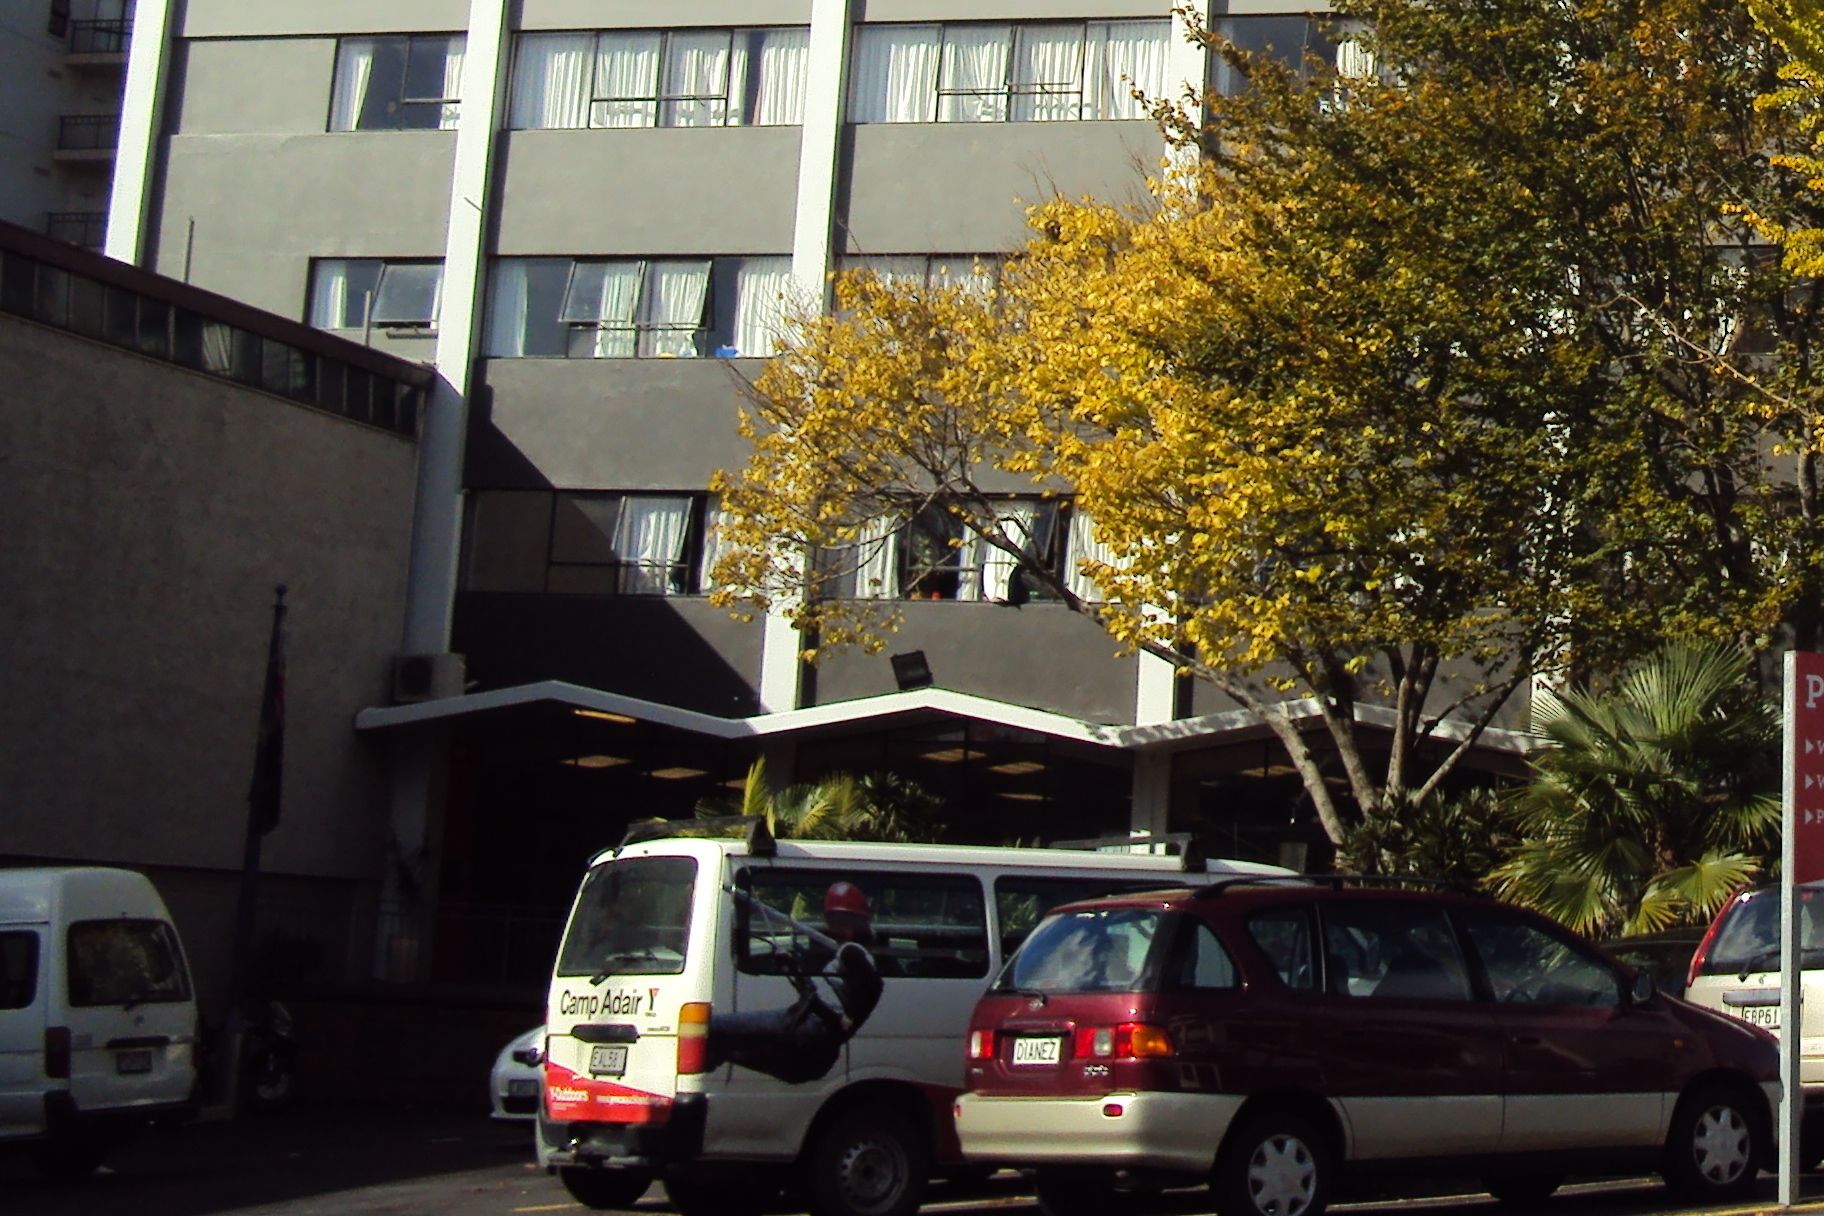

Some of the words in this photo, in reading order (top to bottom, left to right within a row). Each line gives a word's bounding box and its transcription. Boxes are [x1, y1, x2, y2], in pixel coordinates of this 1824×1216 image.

[560, 989, 599, 1020] Camp
[601, 988, 643, 1015] Adair
[1015, 1039, 1057, 1061] DIANEZ
